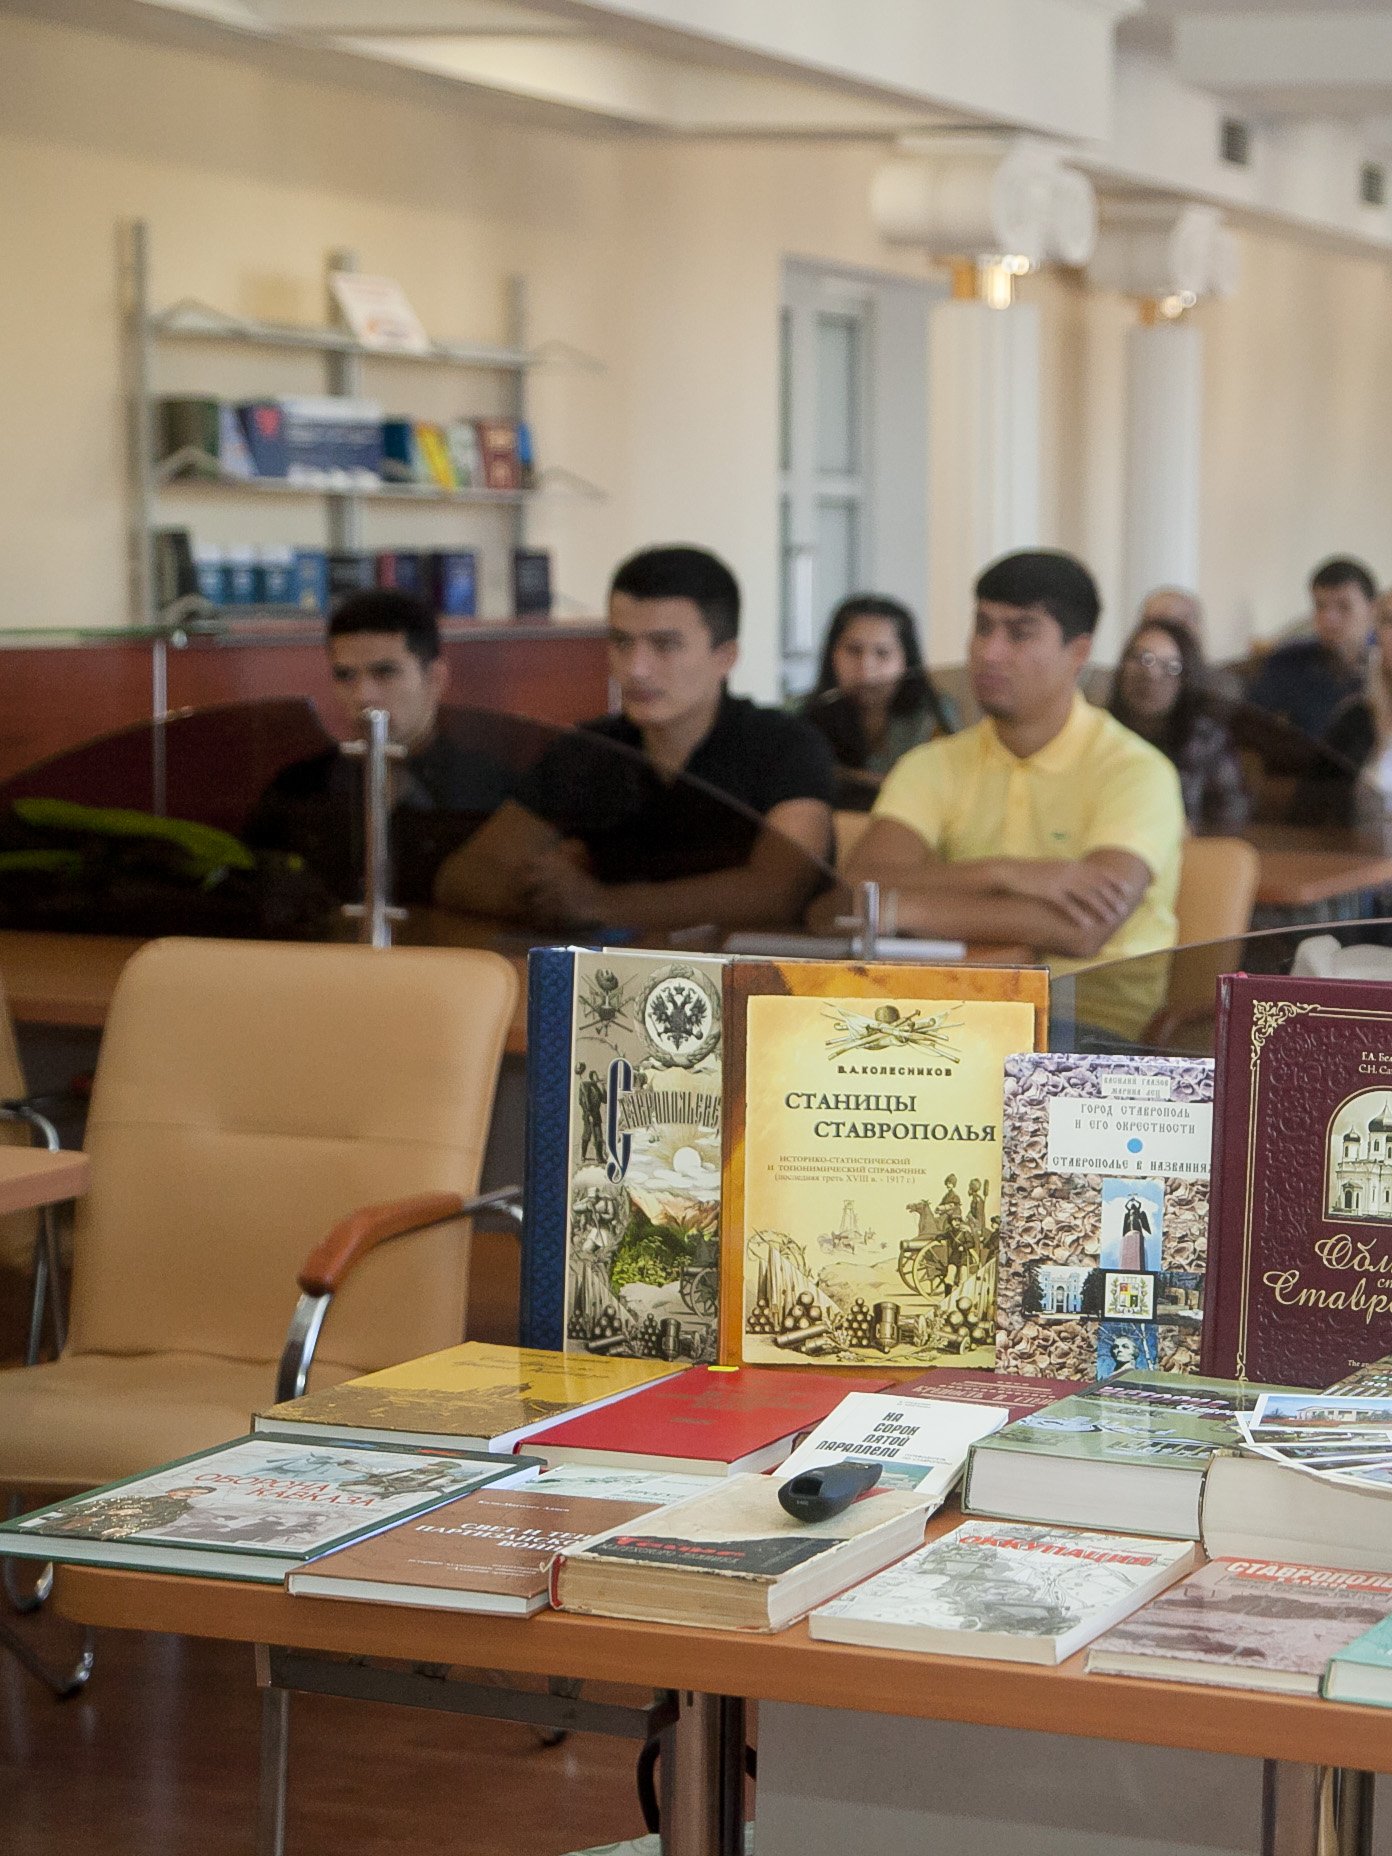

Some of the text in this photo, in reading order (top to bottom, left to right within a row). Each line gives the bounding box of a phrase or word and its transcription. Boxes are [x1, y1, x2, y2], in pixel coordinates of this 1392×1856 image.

[1104, 1076, 1169, 1087] ВАСИЛИЙ ГЛАЗОВ
[1111, 1087, 1141, 1096] МАРИНА
[785, 1092, 917, 1114] СТАНИЦЫ
[1081, 1103, 1190, 1118] ГОРОД СТАВРОПОЛЬ
[814, 1121, 997, 1141] СТАВРОПОЛЬЯ
[1089, 1120, 1109, 1130] ЕГО
[1116, 1121, 1195, 1134] ОКРЕСТНОСТИ
[780, 1155, 911, 1166] ИСТОРИКО-СТАТИСТИЧЕСКИЙ
[1052, 1156, 1210, 1173] СТАВРОПОЛЬЕ В НАЗВАНИЯ
[779, 1164, 866, 1173] ТОПОНИМИЧЕСКИЙ
[868, 1166, 926, 1175] СПРАВОЧНИК
[822, 1175, 844, 1184] треть
[846, 1175, 868, 1183] XVIII
[886, 1176, 904, 1184] 1917
[1348, 1359, 1360, 1367] The
[882, 1412, 903, 1422] НА
[873, 1422, 920, 1435] СОРОК
[863, 1433, 910, 1447] ПЯТОЙ
[194, 1473, 329, 1493] ОБОРОНА
[246, 1487, 376, 1508] КАВКАЗА
[415, 1525, 580, 1546] ПАРТИЗАНСКО
[460, 1522, 593, 1541] СВЕТ И ТЕН
[497, 1541, 563, 1552] ВОЙН
[958, 1534, 1155, 1567] ОККУПАЦИЯ
